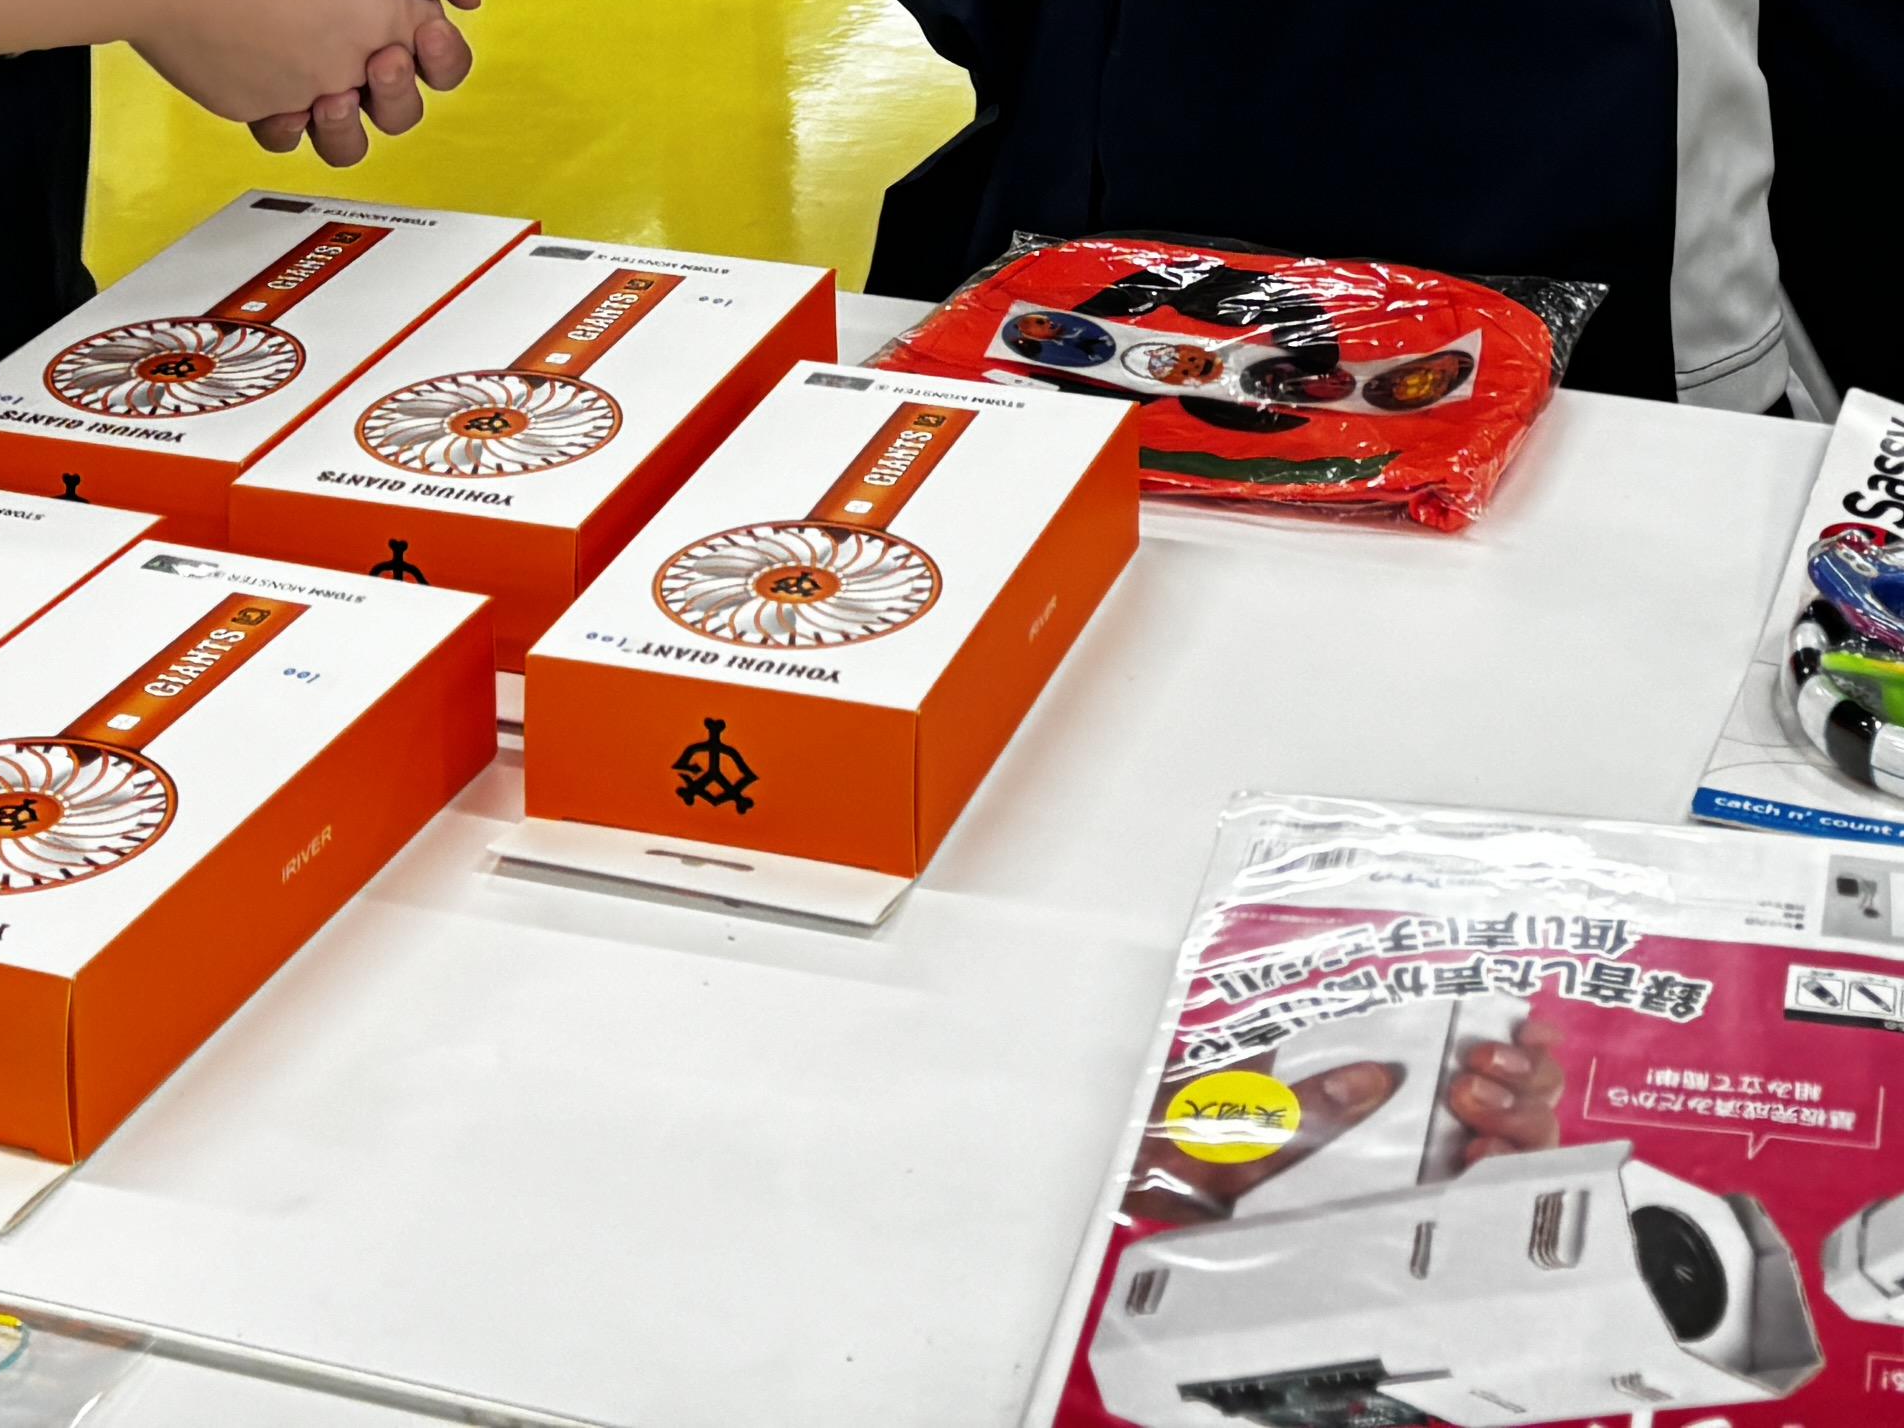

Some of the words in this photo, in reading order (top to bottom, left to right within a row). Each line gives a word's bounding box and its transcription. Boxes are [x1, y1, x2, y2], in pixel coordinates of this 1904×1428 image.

[267, 244, 343, 291] GIANTS
[567, 292, 640, 342] GIANTS
[94, 422, 187, 442] YOMIURI
[863, 430, 932, 487] GIANTS
[316, 470, 405, 493] GIANTS
[408, 480, 515, 507] YOMIURI
[144, 627, 247, 699] GIANTS
[634, 642, 718, 667] GIANT
[723, 654, 841, 684] YOMIURI
[1714, 796, 1781, 817] catch
[1819, 815, 1893, 835] count
[282, 824, 332, 885] IRIVER
